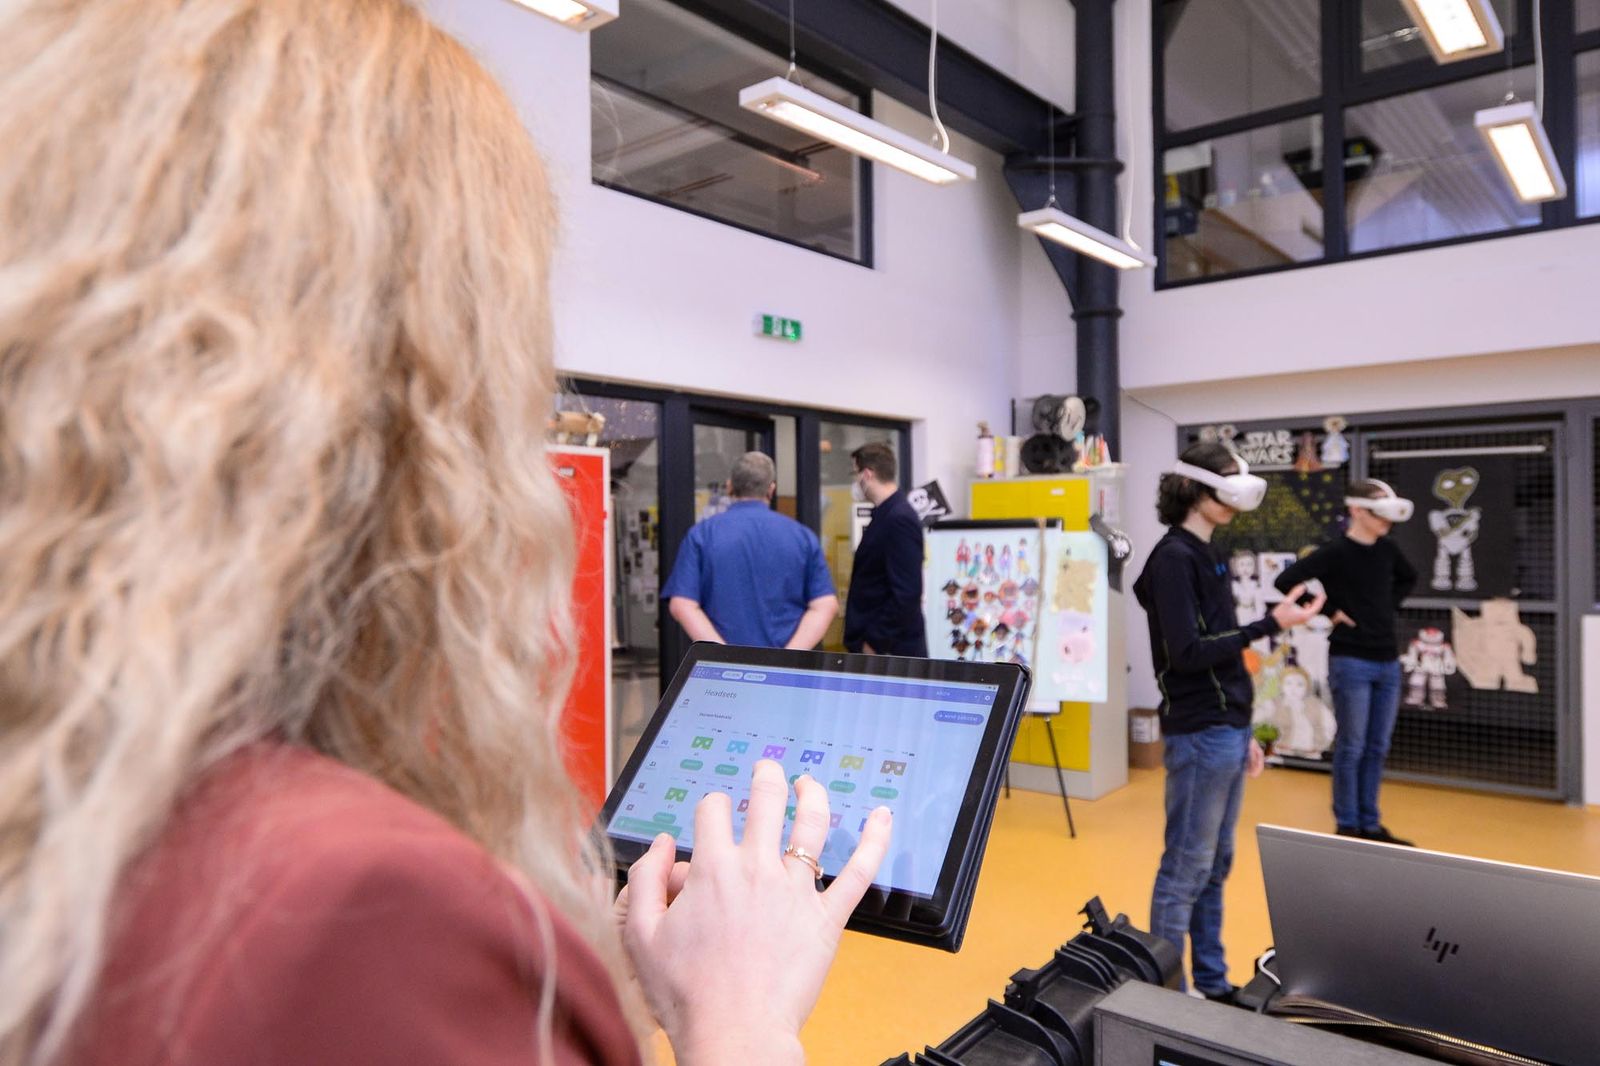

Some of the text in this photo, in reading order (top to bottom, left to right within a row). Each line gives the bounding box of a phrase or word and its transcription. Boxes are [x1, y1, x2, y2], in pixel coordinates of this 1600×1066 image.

[1245, 429, 1291, 447] STAR
[1239, 445, 1293, 465] WARS
[704, 688, 737, 699] Headsets
[1425, 926, 1459, 963] hp
